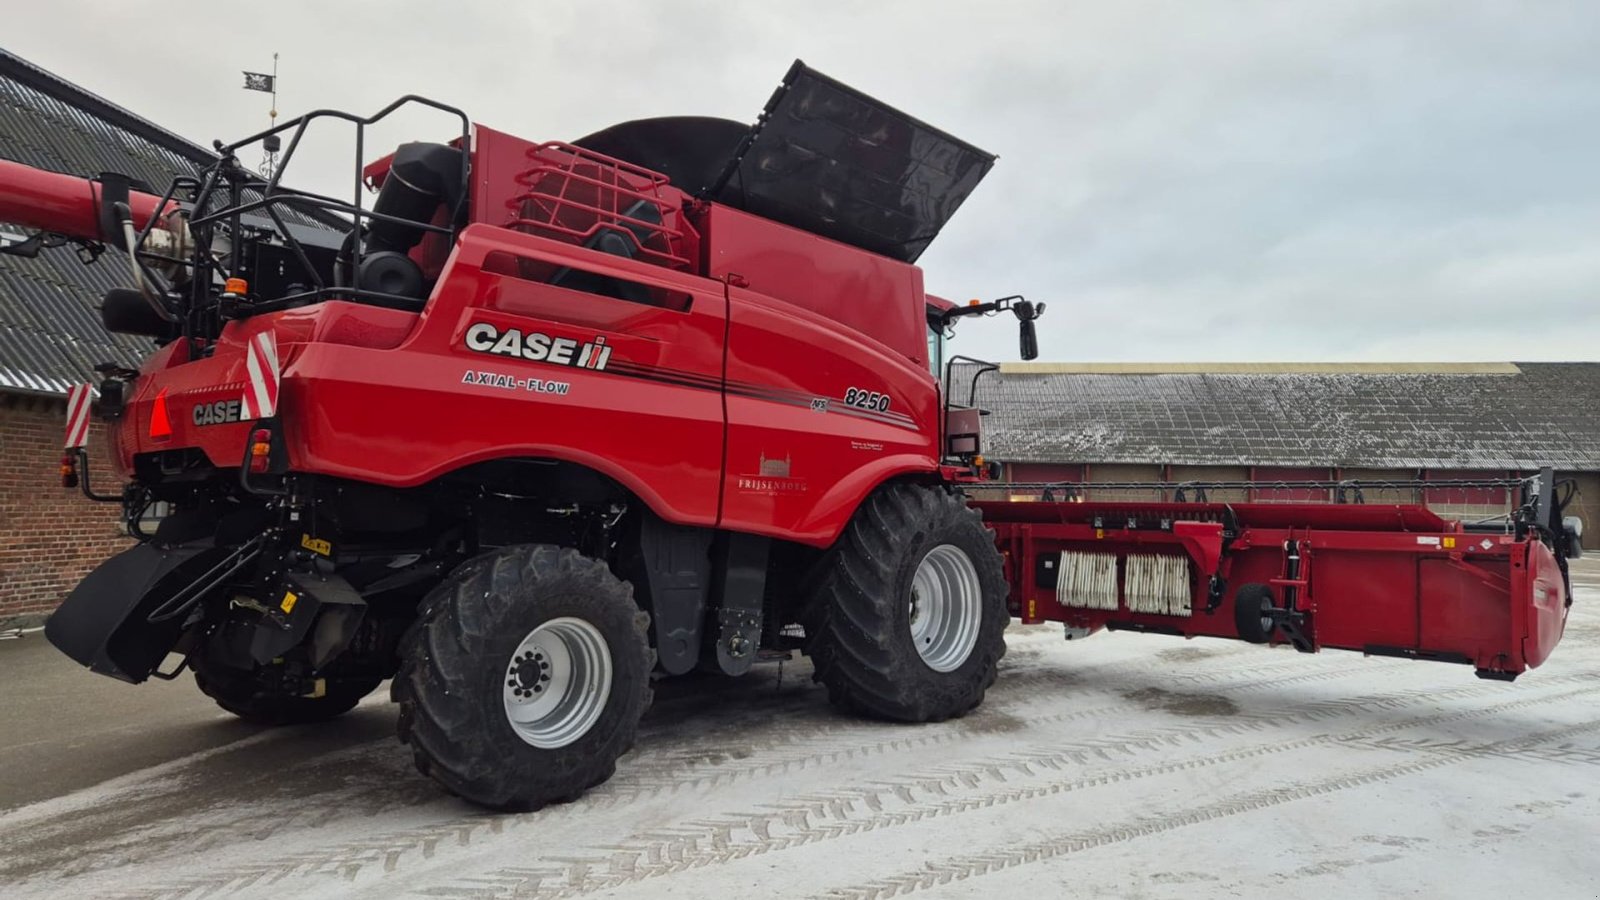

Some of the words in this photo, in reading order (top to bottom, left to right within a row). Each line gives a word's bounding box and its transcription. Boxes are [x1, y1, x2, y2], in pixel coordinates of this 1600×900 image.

[465, 322, 578, 366] CASE
[462, 370, 570, 395] AXIAL-FLOW
[193, 400, 239, 426] CASE
[845, 387, 890, 413] 8250
